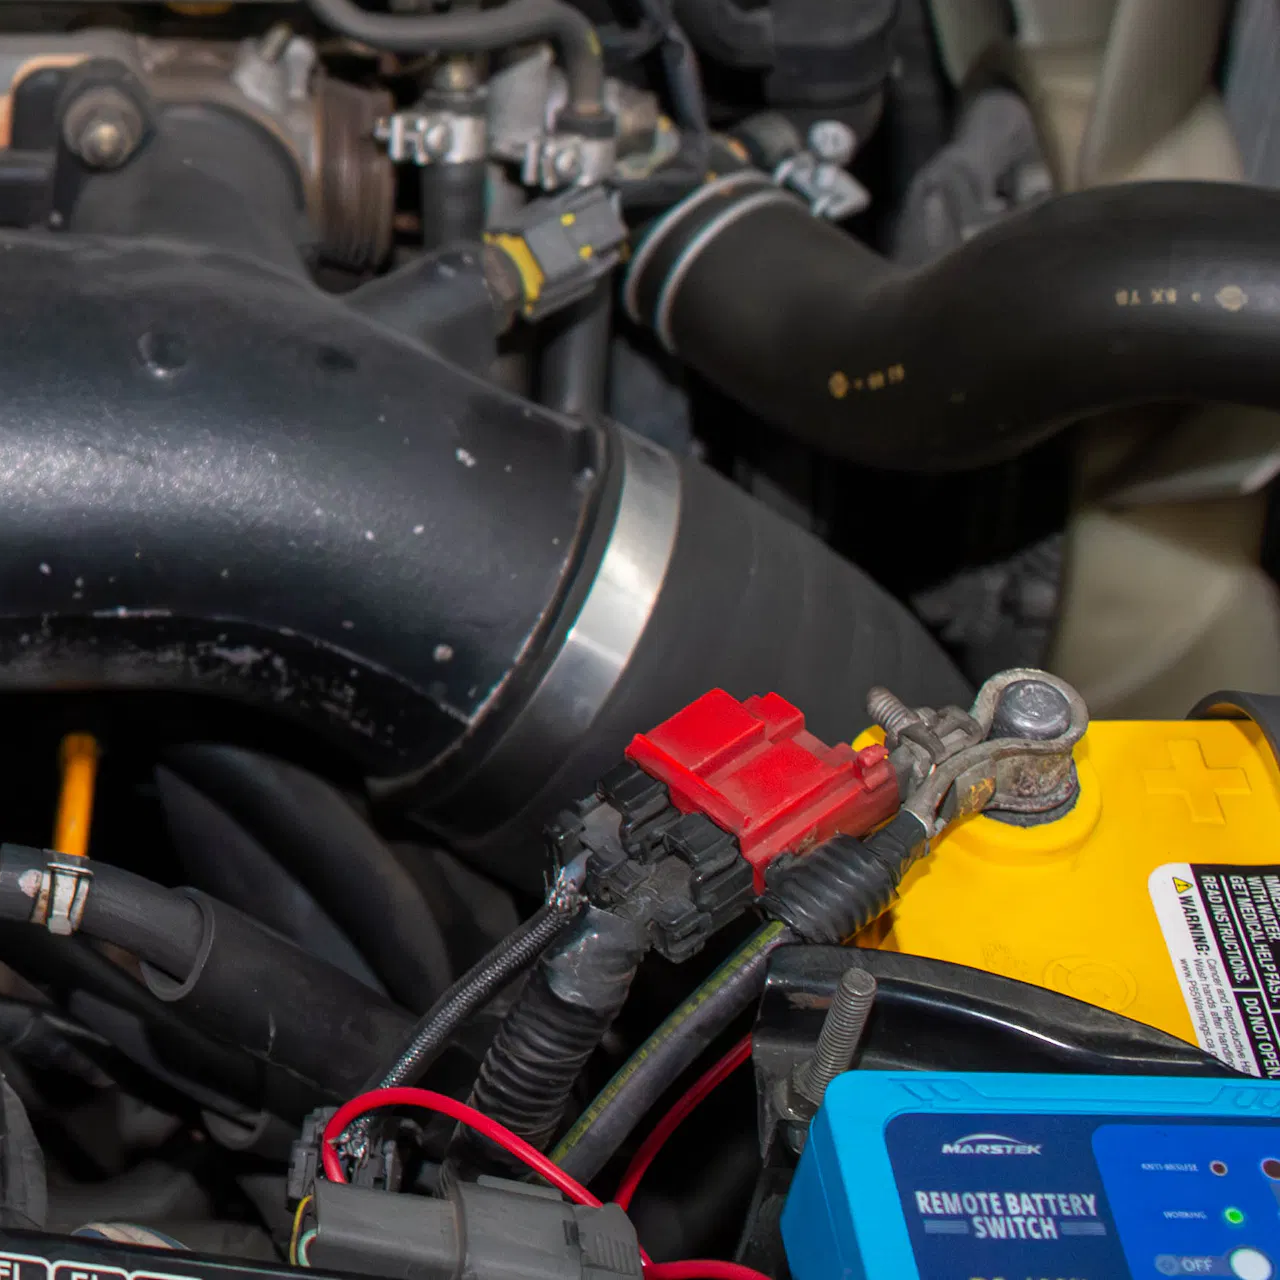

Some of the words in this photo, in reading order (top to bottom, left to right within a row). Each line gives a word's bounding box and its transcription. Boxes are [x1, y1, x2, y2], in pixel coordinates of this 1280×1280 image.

[1201, 876, 1224, 905] READ
[1229, 877, 1249, 896] GET
[1246, 878, 1269, 902] WITH
[1178, 897, 1212, 957] WARNING:
[1237, 900, 1267, 942] MEDICAL
[1211, 906, 1250, 983] INSTRUCTIONS.
[1254, 945, 1277, 971] HELP
[1193, 959, 1209, 982] Wash
[1201, 984, 1218, 1009] hands
[1210, 1011, 1225, 1031] after
[1242, 998, 1262, 1014] DO
[1206, 959, 1224, 986] Cancer
[1219, 1006, 1248, 1059] Reproductive
[1249, 1017, 1271, 1042] NOT
[942, 1143, 1042, 1156] MARSTEK
[915, 1190, 1004, 1215] REMOTE
[1004, 1192, 1097, 1217] BATTERY
[972, 1216, 1059, 1240] SWITCH
[1181, 1258, 1213, 1273] OFF
